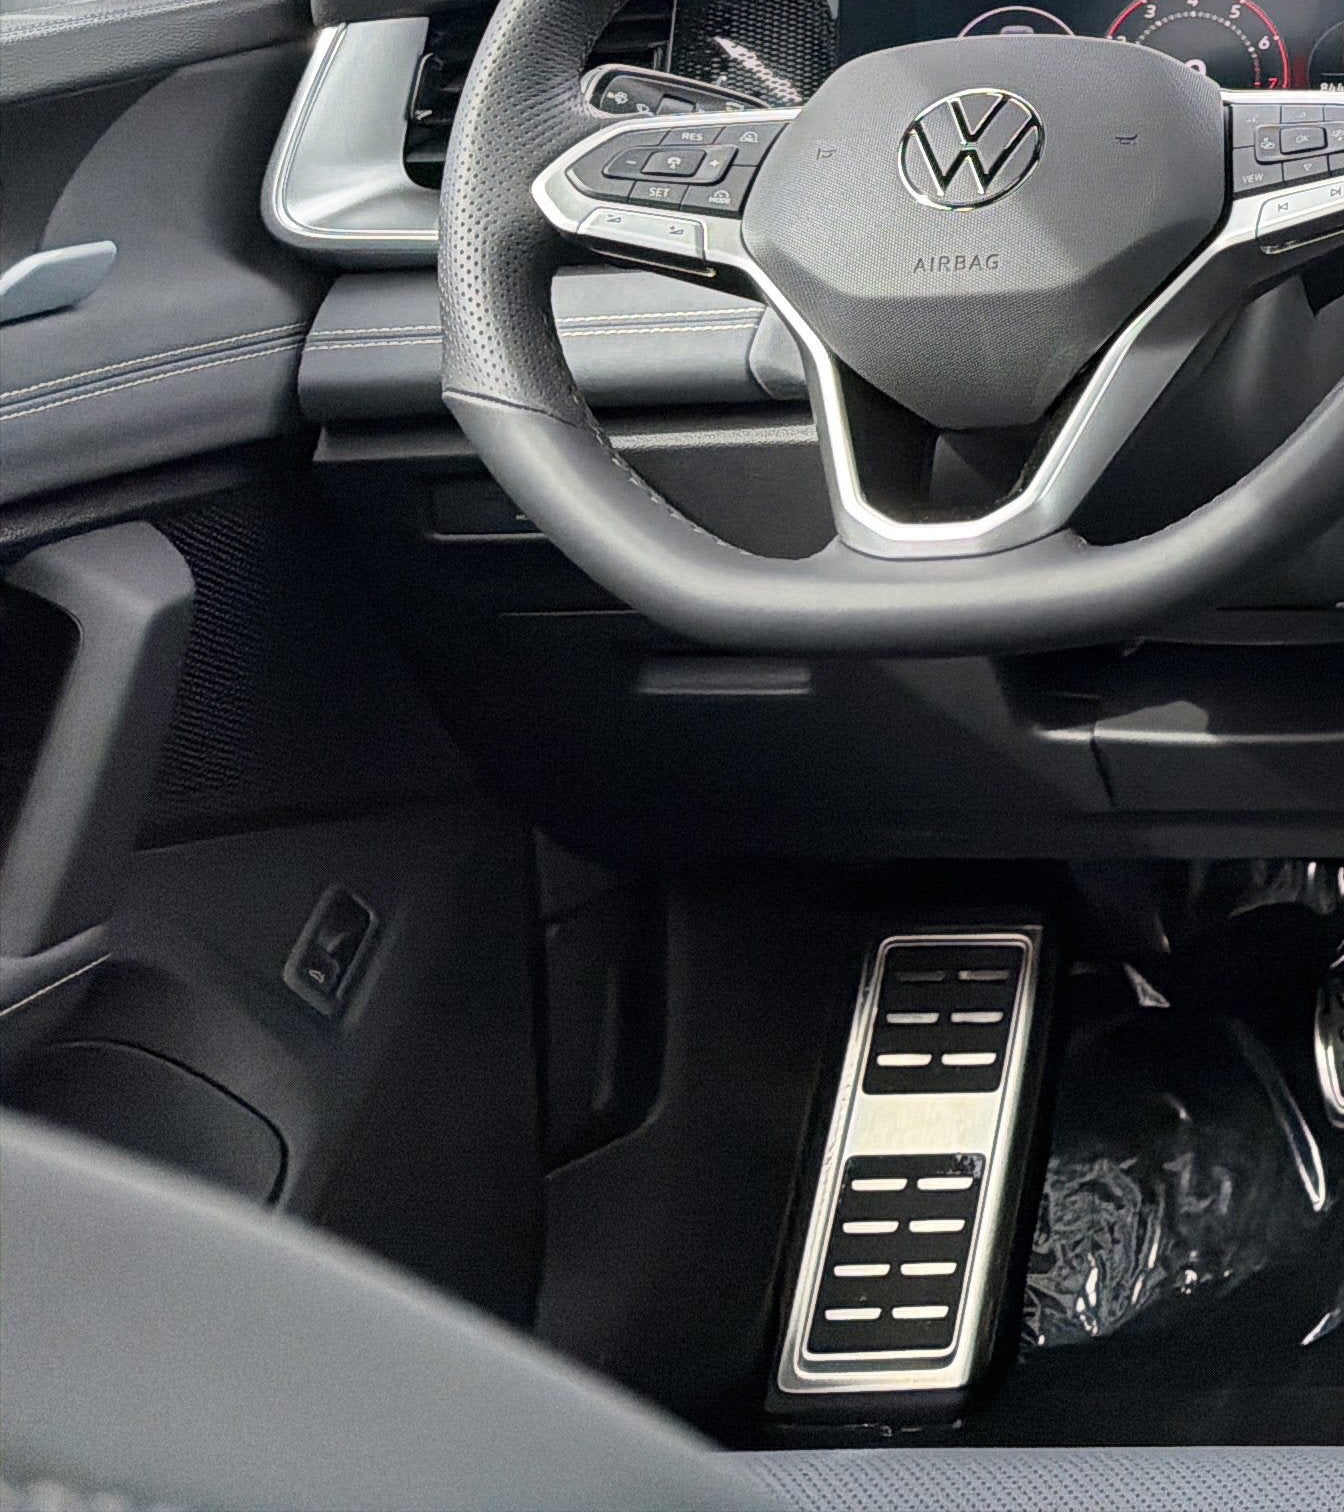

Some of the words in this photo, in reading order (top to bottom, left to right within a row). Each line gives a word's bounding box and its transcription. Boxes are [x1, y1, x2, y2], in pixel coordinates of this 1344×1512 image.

[1143, 4, 1157, 19] 3
[1228, 4, 1242, 19] 5
[1258, 35, 1271, 50] 6
[681, 132, 703, 142] RES
[1242, 172, 1265, 184] VIEW
[649, 187, 671, 199] SET
[913, 253, 1001, 274] AIRBAG
